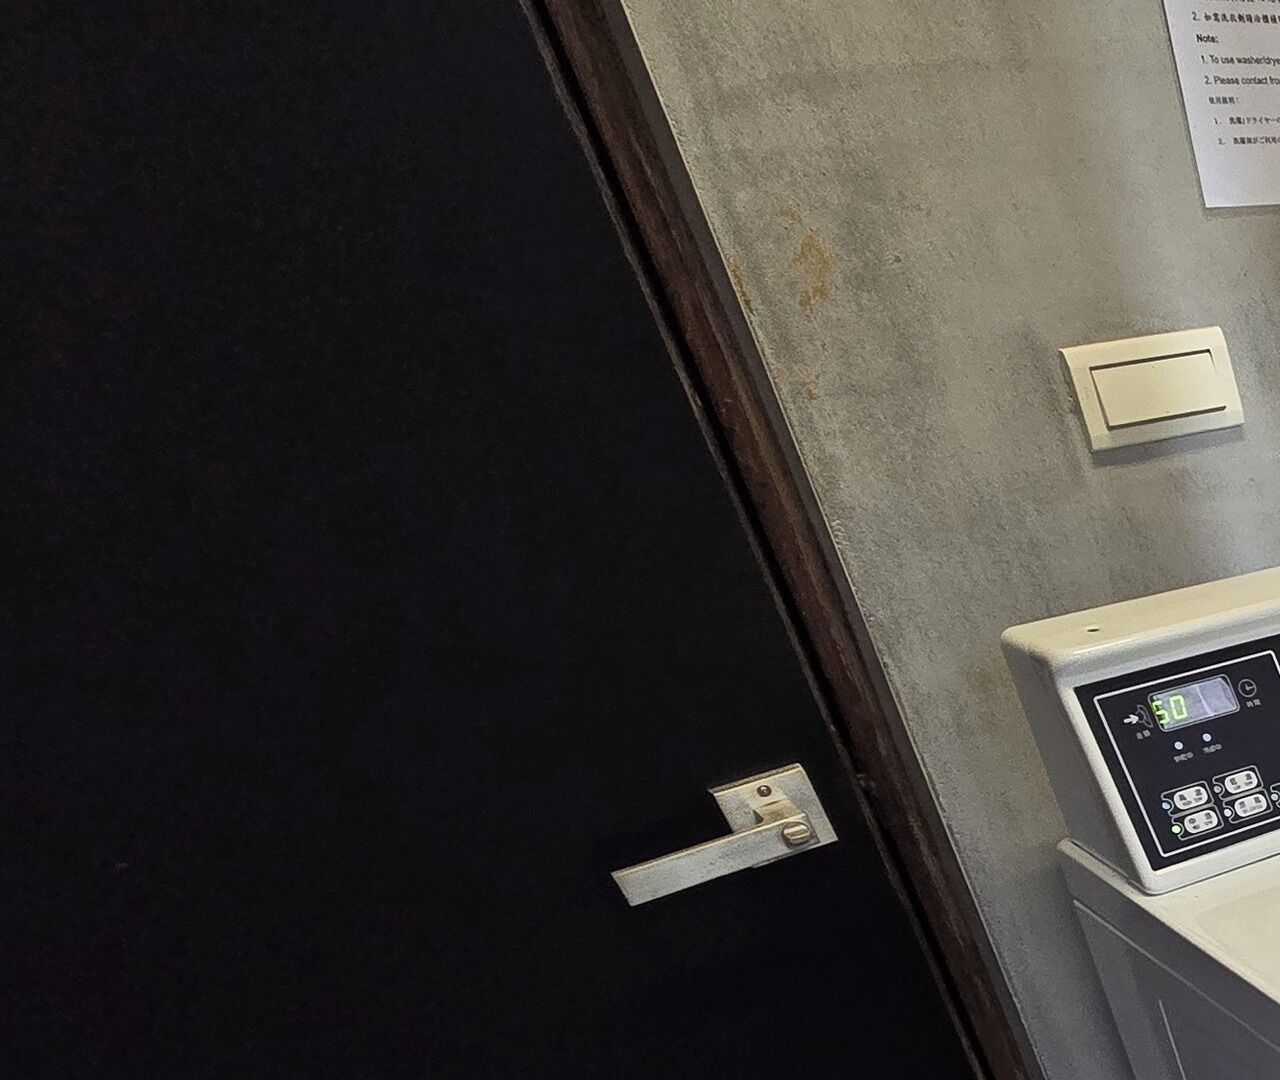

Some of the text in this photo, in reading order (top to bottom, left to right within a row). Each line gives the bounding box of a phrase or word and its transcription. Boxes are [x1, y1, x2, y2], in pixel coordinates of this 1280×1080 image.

[1196, 33, 1219, 43] Note:
[1209, 55, 1219, 64] To
[1220, 57, 1234, 65] use
[1213, 76, 1239, 85] Please
[1241, 76, 1268, 85] contact
